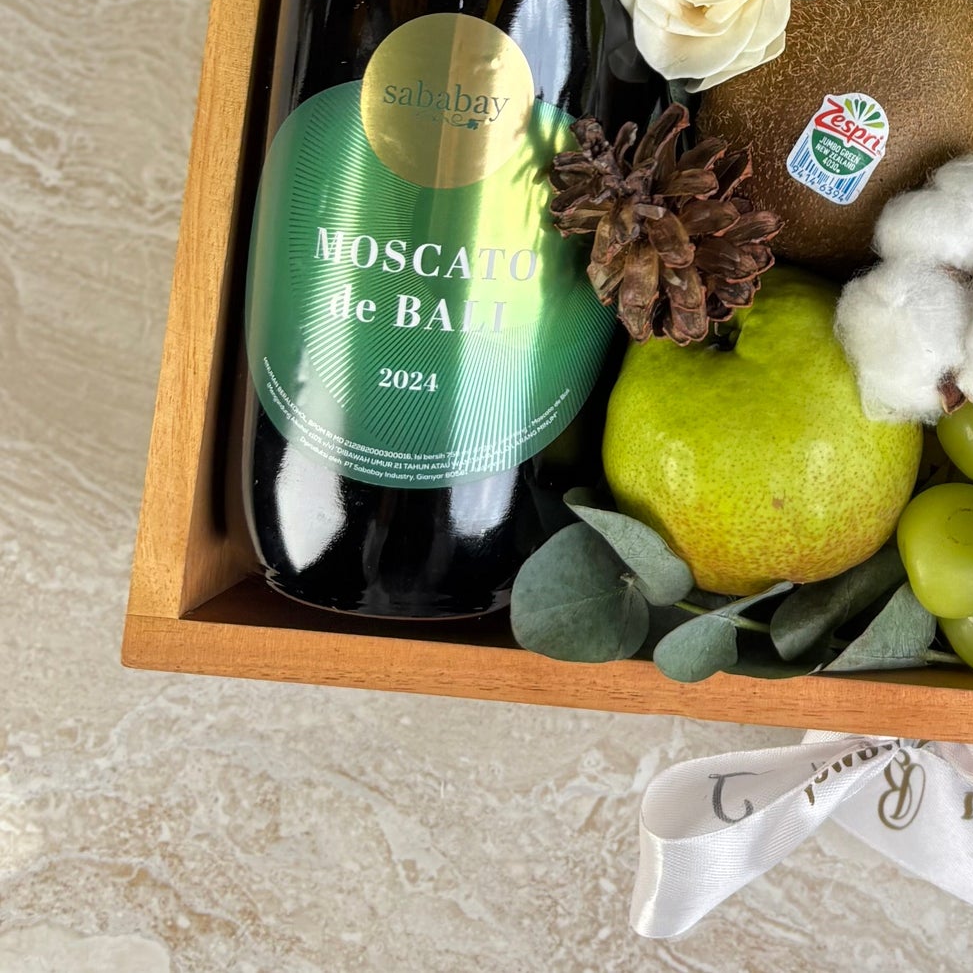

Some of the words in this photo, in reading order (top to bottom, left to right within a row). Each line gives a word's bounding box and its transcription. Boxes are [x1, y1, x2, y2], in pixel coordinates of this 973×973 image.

[383, 80, 510, 122] sababay
[814, 98, 884, 151] Zespri
[815, 144, 831, 156] NEW
[828, 151, 856, 171] ZEALAND
[819, 136, 842, 152] JUMBO
[839, 147, 860, 165] GREEN
[822, 157, 839, 172] 4030
[792, 165, 816, 186] 9414
[819, 183, 844, 202] 6394
[314, 226, 538, 281] MOSCATO
[329, 283, 377, 323] de
[392, 293, 507, 333] BALI
[378, 368, 438, 393] 2024
[343, 460, 353, 468] PT
[353, 463, 384, 479] Sababay
[416, 473, 444, 482] Gianyar
[370, 458, 393, 468] UMUR
[393, 462, 402, 470] 21
[430, 461, 451, 469] ATAU
